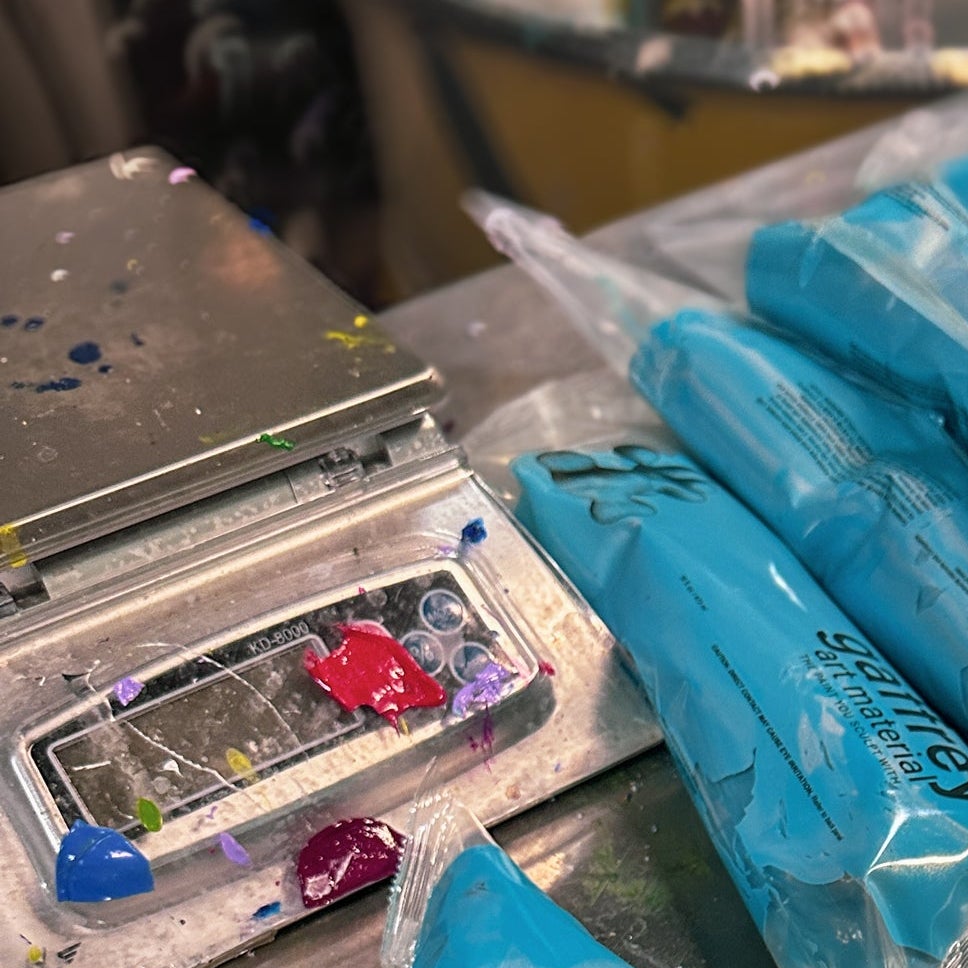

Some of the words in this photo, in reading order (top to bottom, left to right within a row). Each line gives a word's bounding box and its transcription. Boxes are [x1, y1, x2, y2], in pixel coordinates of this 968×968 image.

[248, 621, 311, 656] KD-8000
[814, 650, 857, 680] art
[843, 685, 938, 782] material
[815, 671, 839, 698] PAINT
[834, 699, 858, 723] YOU
[850, 721, 883, 756] SCULPT
[879, 755, 900, 785] WITH
